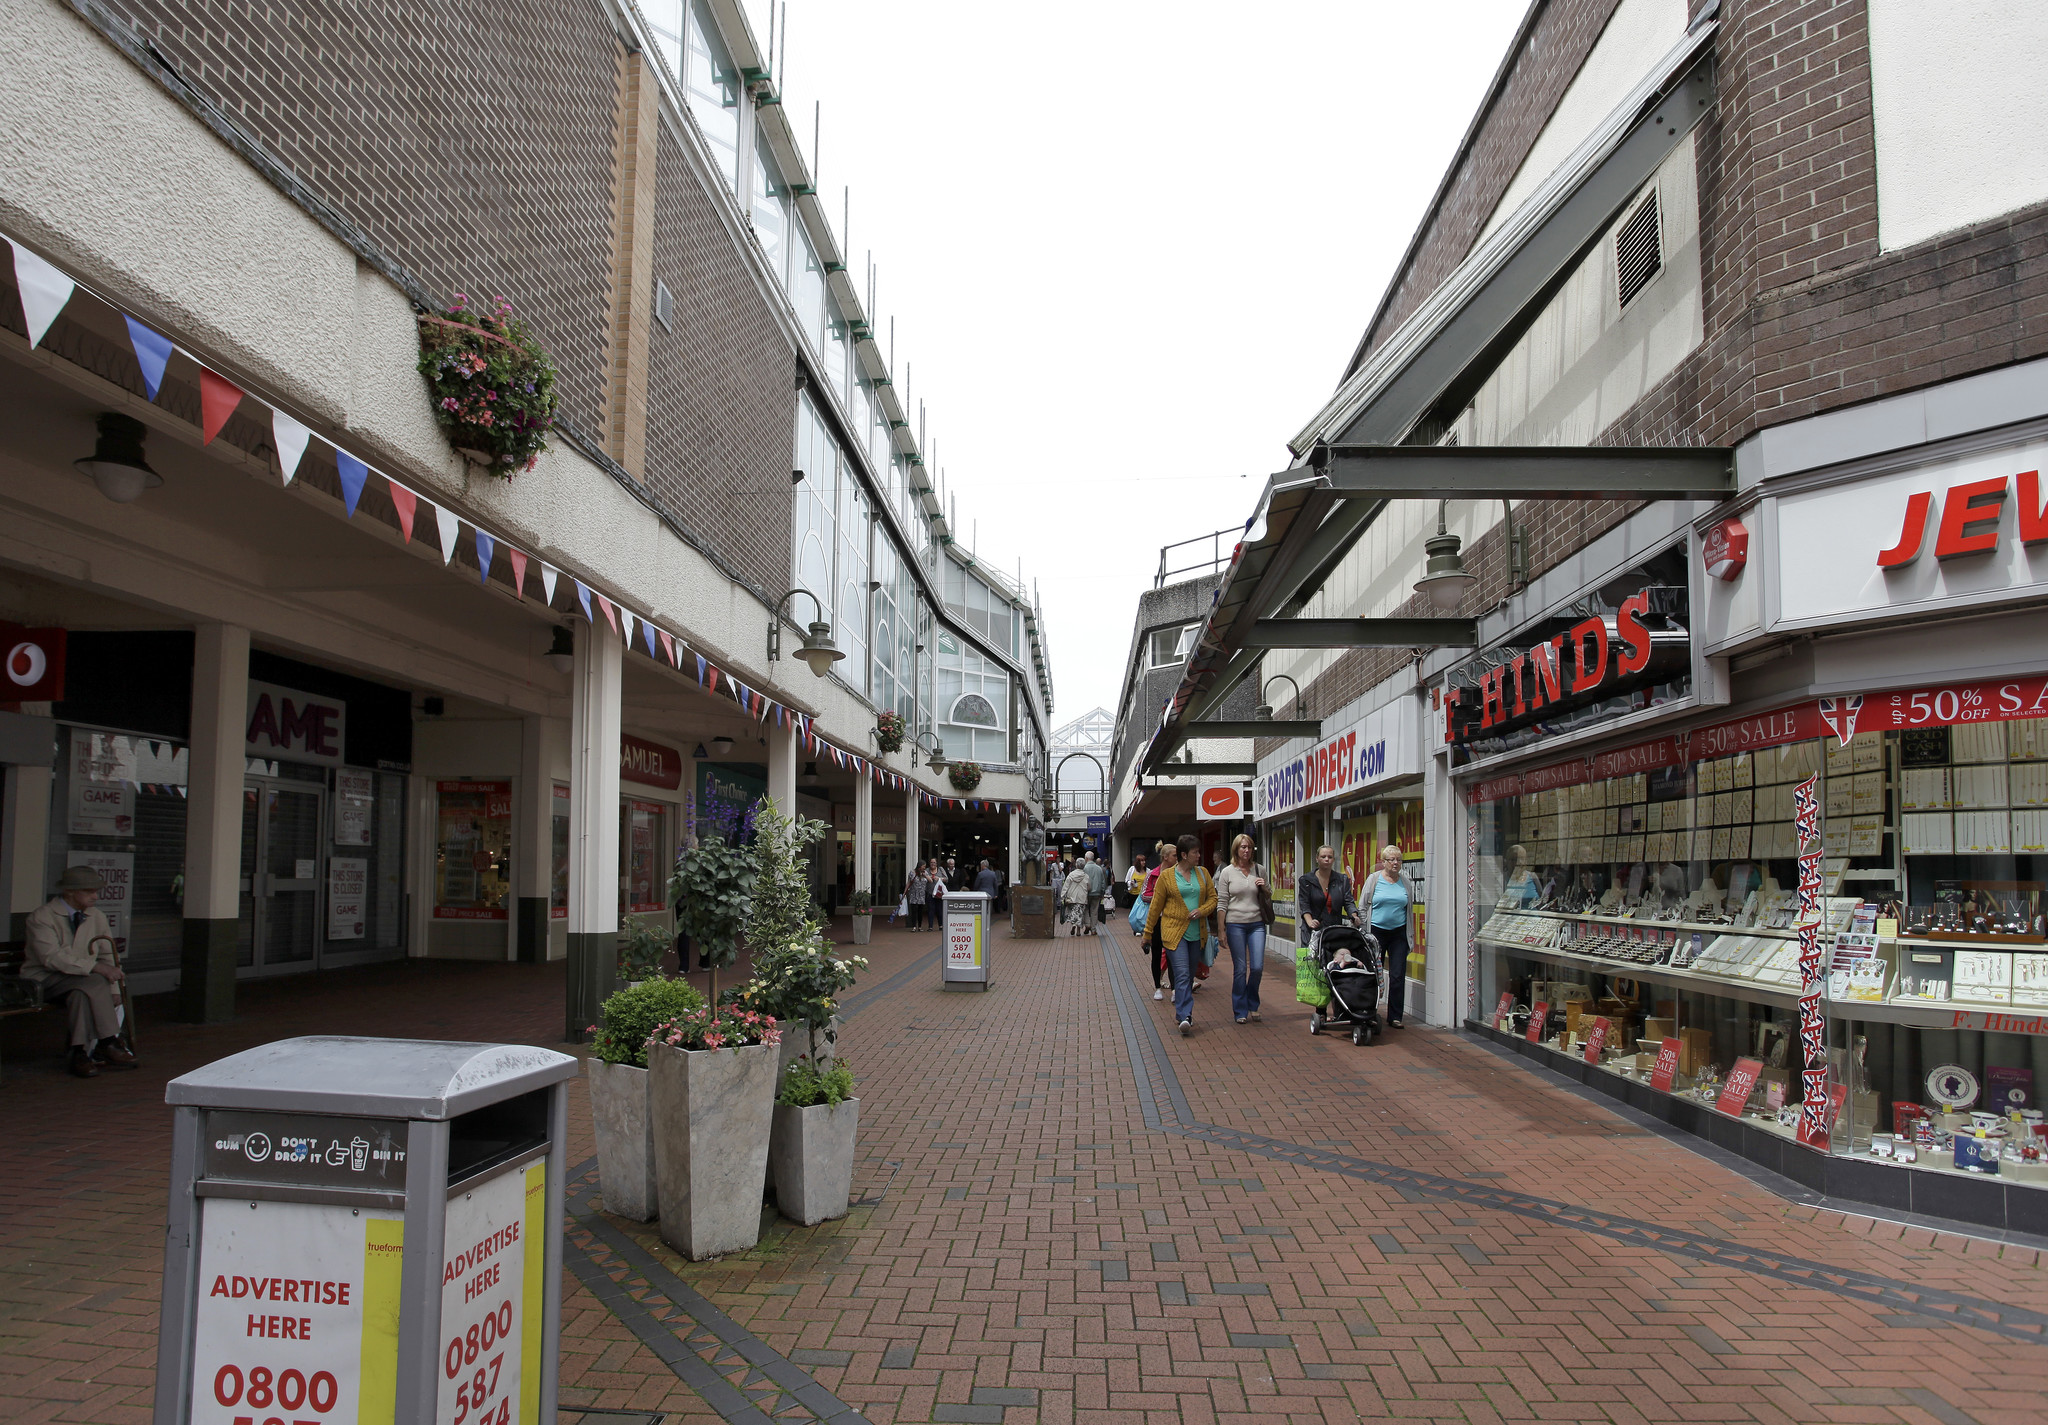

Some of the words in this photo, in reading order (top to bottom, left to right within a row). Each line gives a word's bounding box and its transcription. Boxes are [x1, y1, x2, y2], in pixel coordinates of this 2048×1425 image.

[1909, 688, 1983, 724] 50%
[1961, 708, 1991, 721] OFF
[2012, 709, 2047, 717] SELECTED
[247, 693, 340, 757] AME
[1740, 710, 1797, 745] SALE
[1906, 730, 1943, 741] GOLD
[1907, 741, 1942, 752] CASH
[1629, 741, 1668, 768] SALE
[1550, 762, 1579, 784] SALE
[478, 784, 496, 792] SALE
[1492, 778, 1514, 796] SALE
[83, 790, 120, 805] GAME
[490, 803, 511, 816] SAL
[1397, 811, 1425, 854] SALE
[98, 868, 129, 884] STORE
[333, 870, 345, 881] THIS
[347, 870, 364, 882] STORE
[99, 886, 125, 900] OSED
[333, 883, 340, 894] IS
[341, 883, 363, 894] CLOSED
[336, 904, 358, 915] GAME
[476, 910, 493, 918] SALE
[950, 935, 972, 943] 0800
[951, 952, 972, 960] 4474
[1529, 1019, 1542, 1028] SALE
[1952, 1010, 1973, 1029] F.
[1983, 1012, 2048, 1035] Hinds
[1589, 1038, 1602, 1048] SALE
[1654, 1060, 1674, 1073] SALE
[1733, 1071, 1752, 1085] 50%
[1724, 1082, 1749, 1097] SALE
[215, 1140, 239, 1151] GUM
[281, 1137, 318, 1149] DON'T
[274, 1151, 305, 1163] DROP
[310, 1154, 322, 1164] IT
[372, 1150, 391, 1161] BIN
[394, 1151, 406, 1162] IT
[367, 1242, 403, 1253] trueform
[443, 1221, 520, 1287] ADVERTISE
[464, 1262, 501, 1305] HERE
[210, 1275, 351, 1306] ADVERTISE
[246, 1314, 311, 1341] HERE
[445, 1299, 513, 1380] 0800
[213, 1364, 338, 1414] 0800
[453, 1351, 505, 1425] 587
